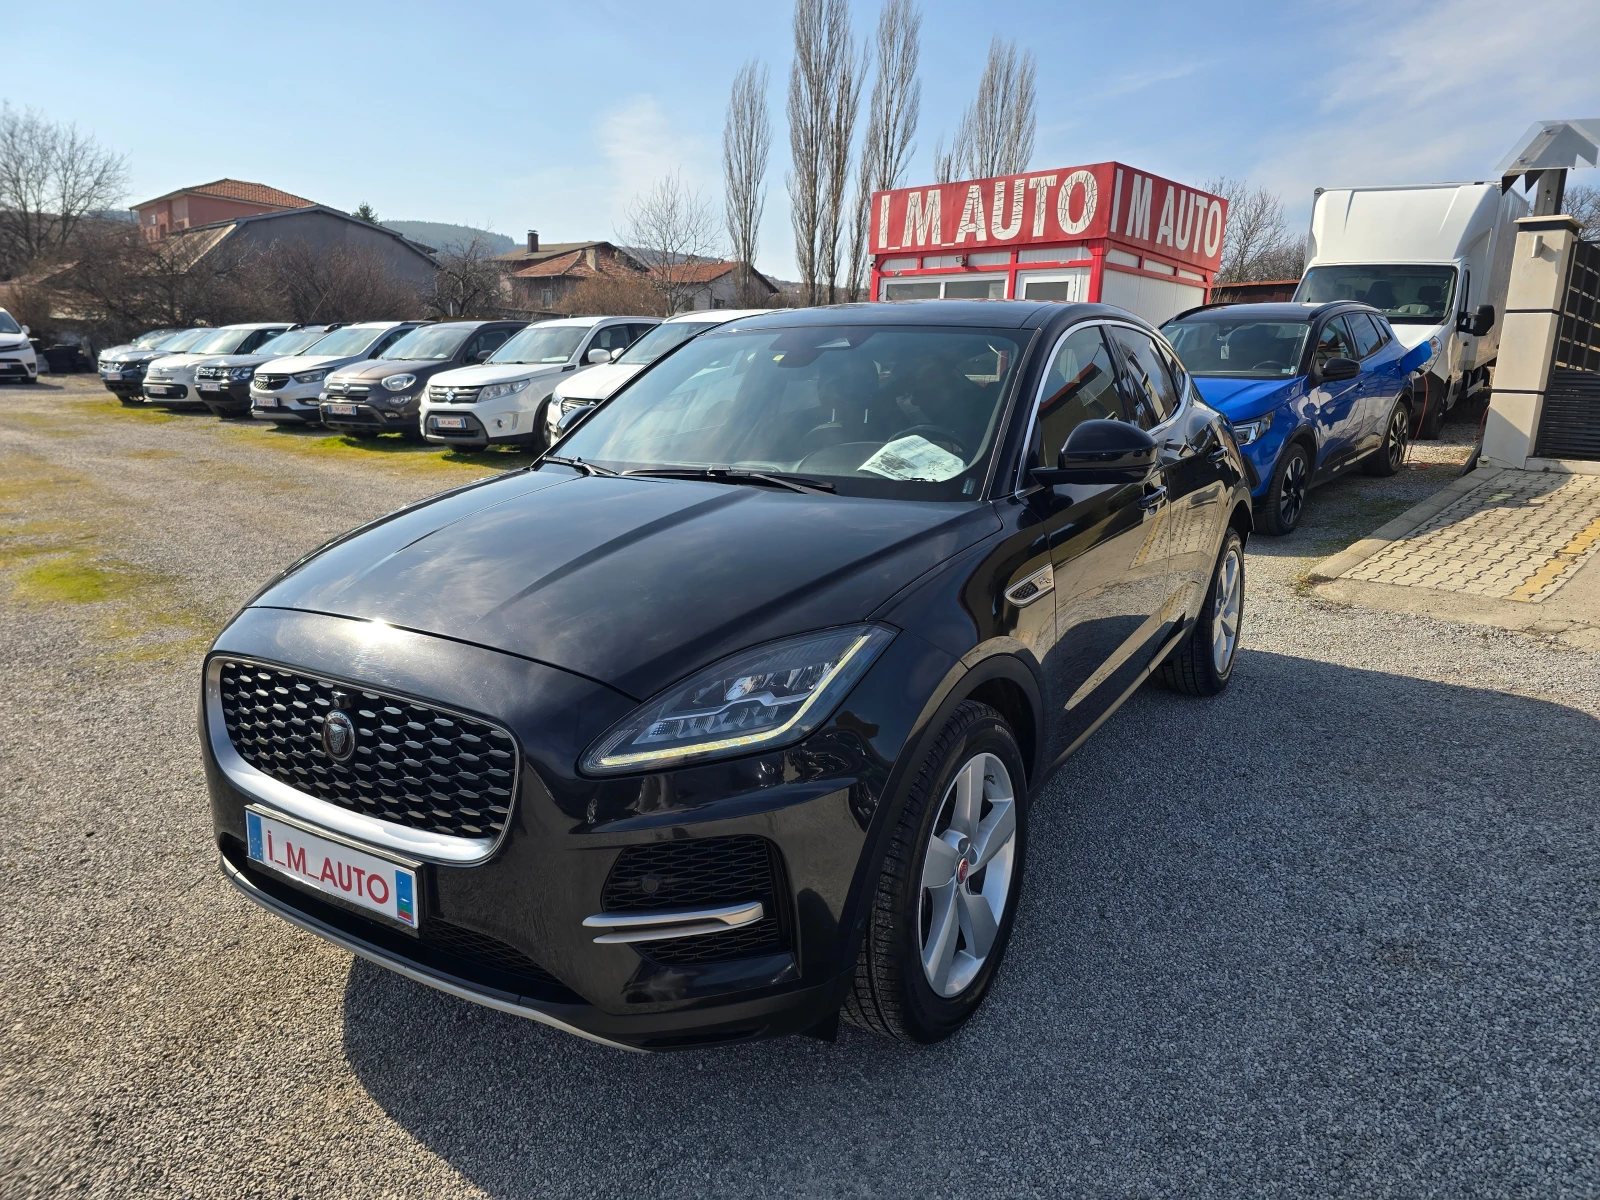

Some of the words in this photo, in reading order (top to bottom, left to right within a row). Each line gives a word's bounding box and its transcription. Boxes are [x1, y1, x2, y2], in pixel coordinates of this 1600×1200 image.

[1110, 168, 1123, 233] I
[1125, 173, 1153, 241] M
[1155, 185, 1222, 258] AUTO
